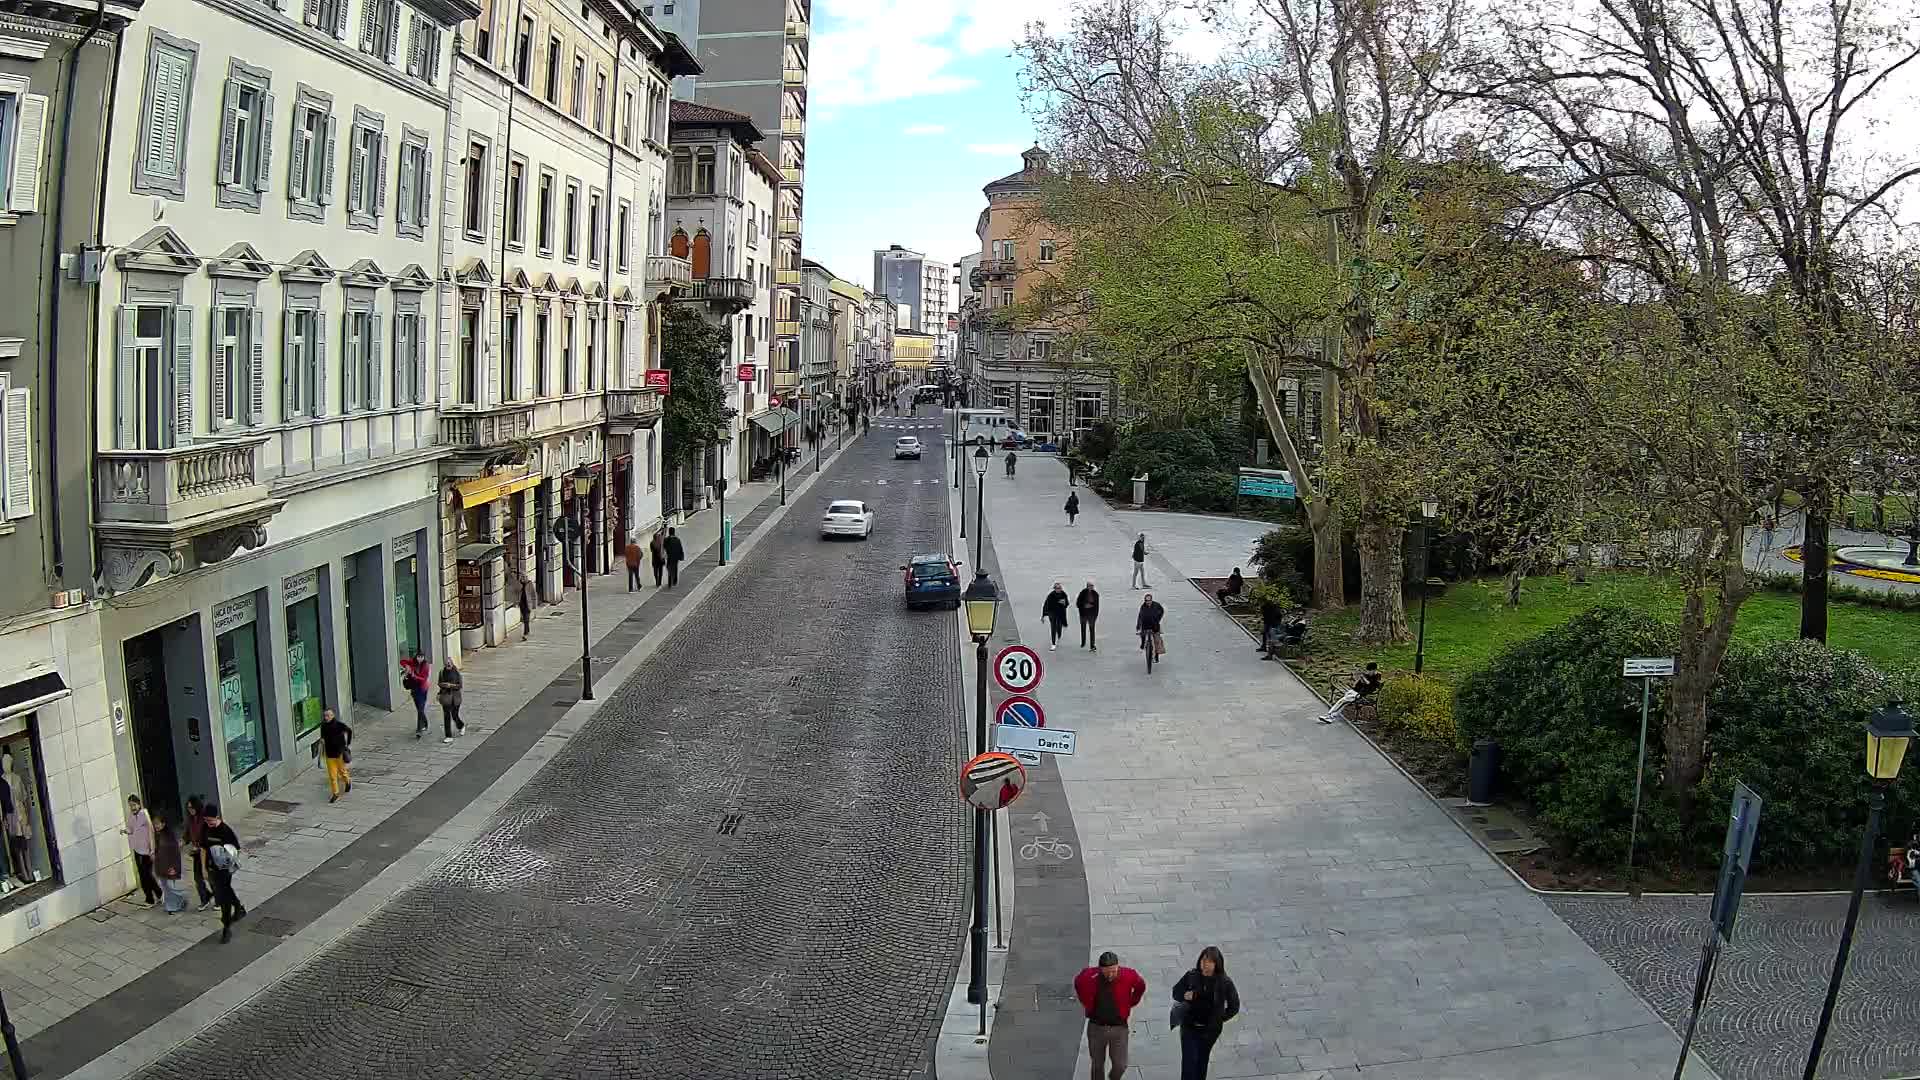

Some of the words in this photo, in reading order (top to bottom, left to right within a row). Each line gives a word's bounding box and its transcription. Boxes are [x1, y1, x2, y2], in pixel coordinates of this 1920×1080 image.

[1005, 658, 1033, 681] 30
[220, 678, 240, 701] 130
[1038, 738, 1070, 750] Dante
